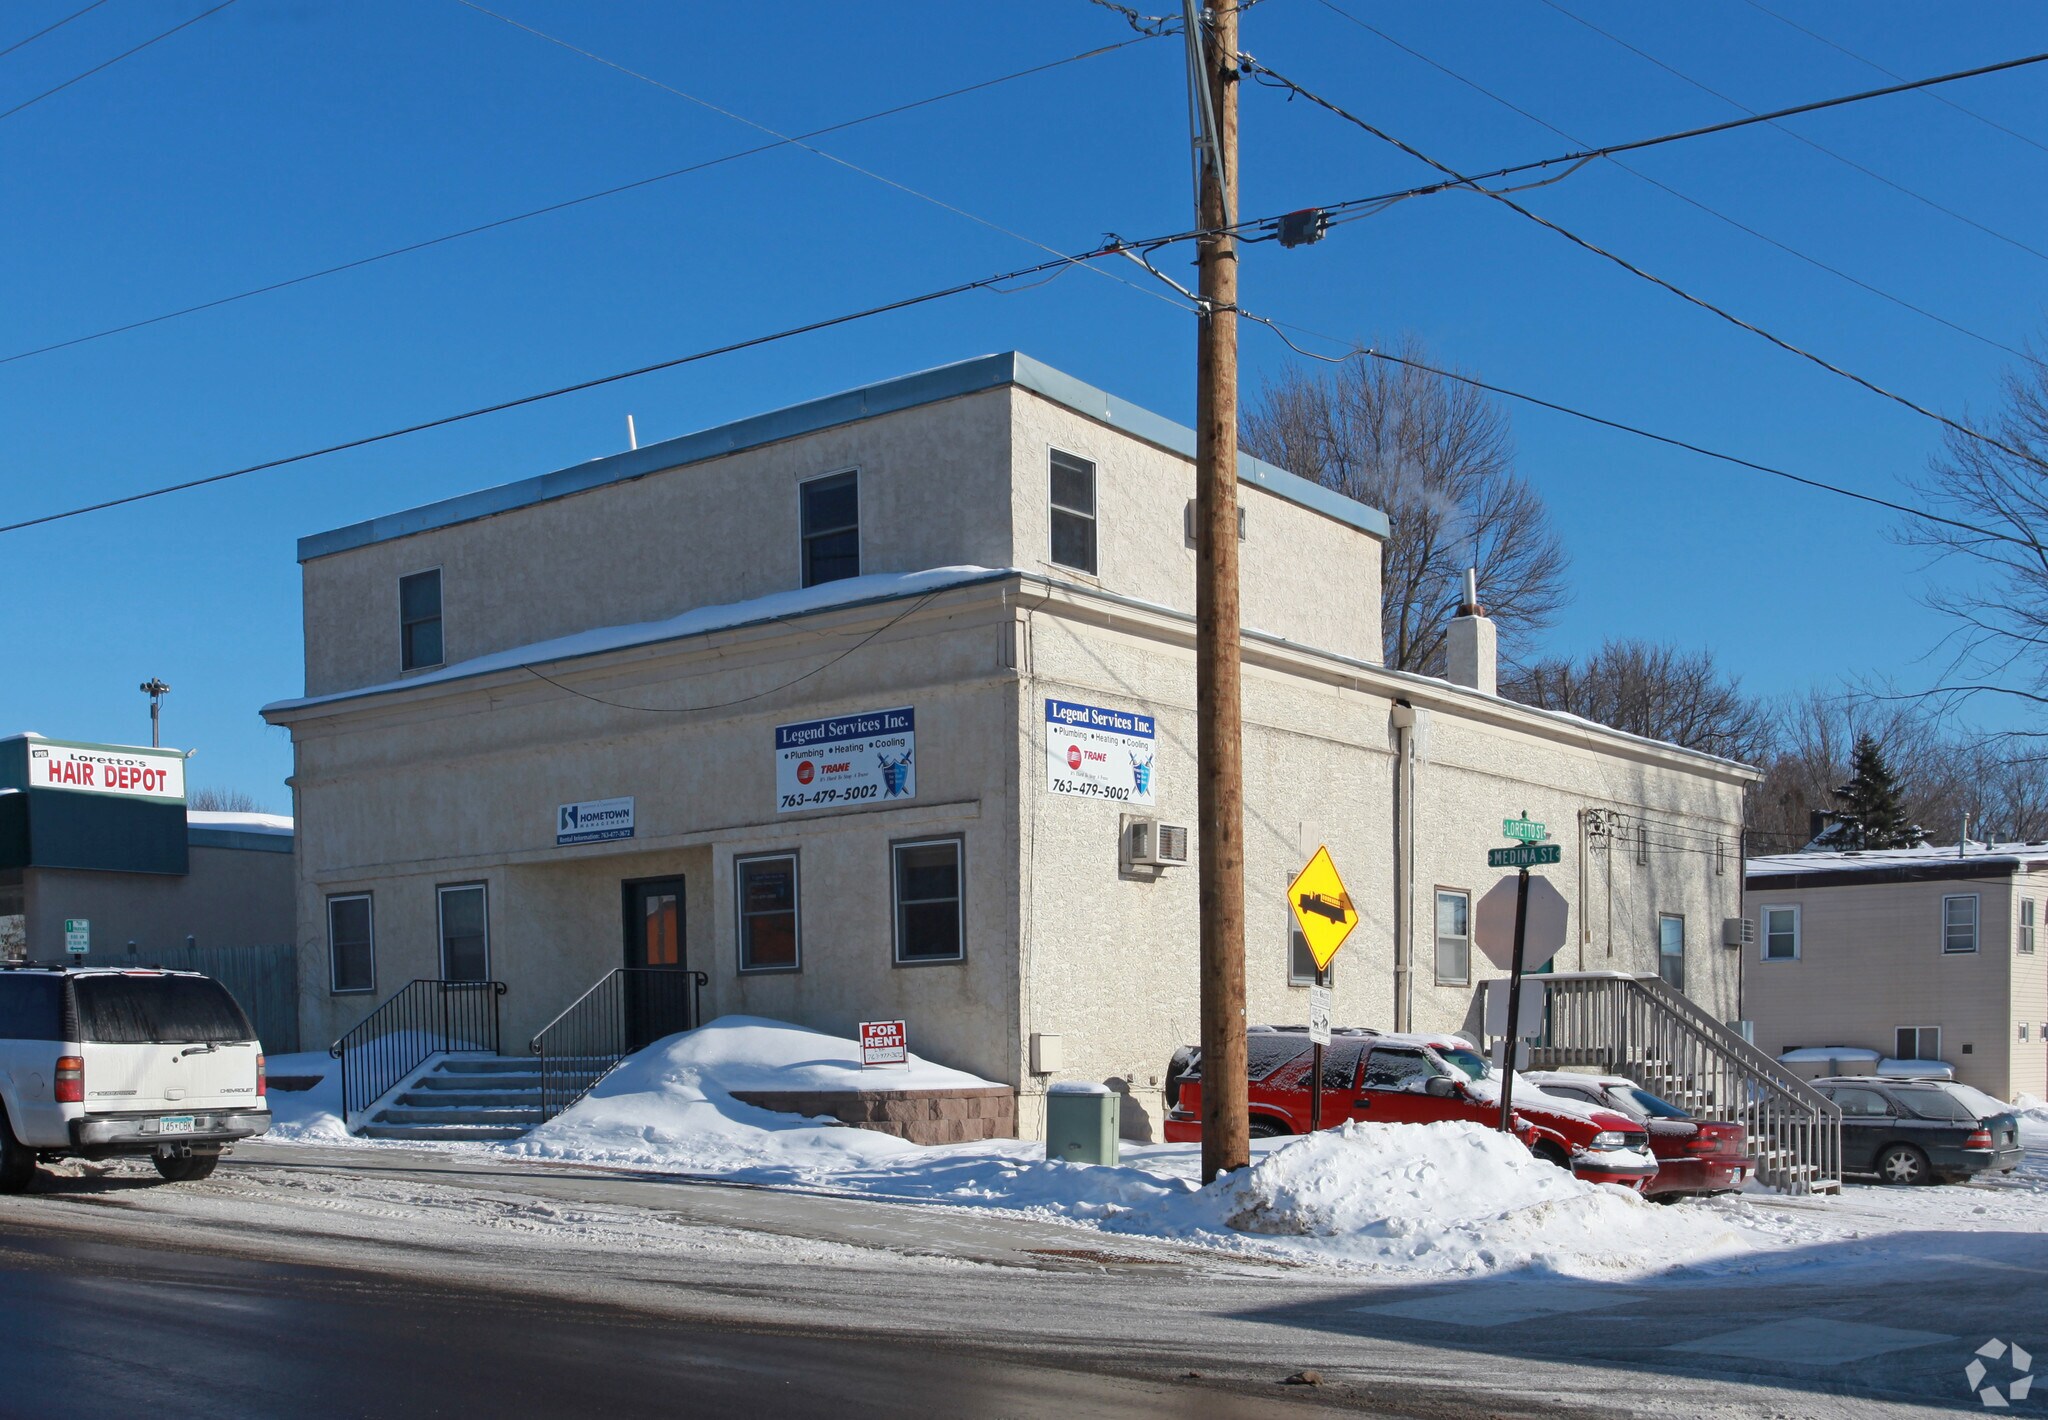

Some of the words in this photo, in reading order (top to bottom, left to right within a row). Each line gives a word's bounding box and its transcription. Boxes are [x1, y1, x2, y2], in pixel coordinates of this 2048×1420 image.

[1052, 702, 1089, 724] Legend
[1091, 709, 1132, 730] Services
[1134, 716, 1152, 734] Inc.
[782, 723, 825, 745] Legend
[828, 718, 880, 737] Services
[884, 714, 909, 729] Inc.
[1059, 726, 1087, 741] Plumbing
[1095, 733, 1119, 746] Heating
[1126, 738, 1149, 751] Cooling
[790, 748, 824, 760] Plumbing
[835, 743, 864, 754] Heating
[875, 737, 905, 749] Cooling
[1084, 750, 1107, 762] TRANE
[70, 753, 147, 768] Loretto's
[820, 762, 851, 774] TRANE
[49, 759, 94, 786] HAIR
[104, 765, 167, 792] DEPOT
[781, 784, 878, 808] 763-479-5002
[1052, 778, 1130, 801] 763-479-5002
[580, 808, 630, 823] HOMETOWN
[580, 819, 630, 828] MANAGEMENT
[1506, 821, 1536, 838] LORETTO
[1494, 848, 1537, 865] MEDINA
[868, 1025, 897, 1037] FOR
[864, 1035, 902, 1048] RENT
